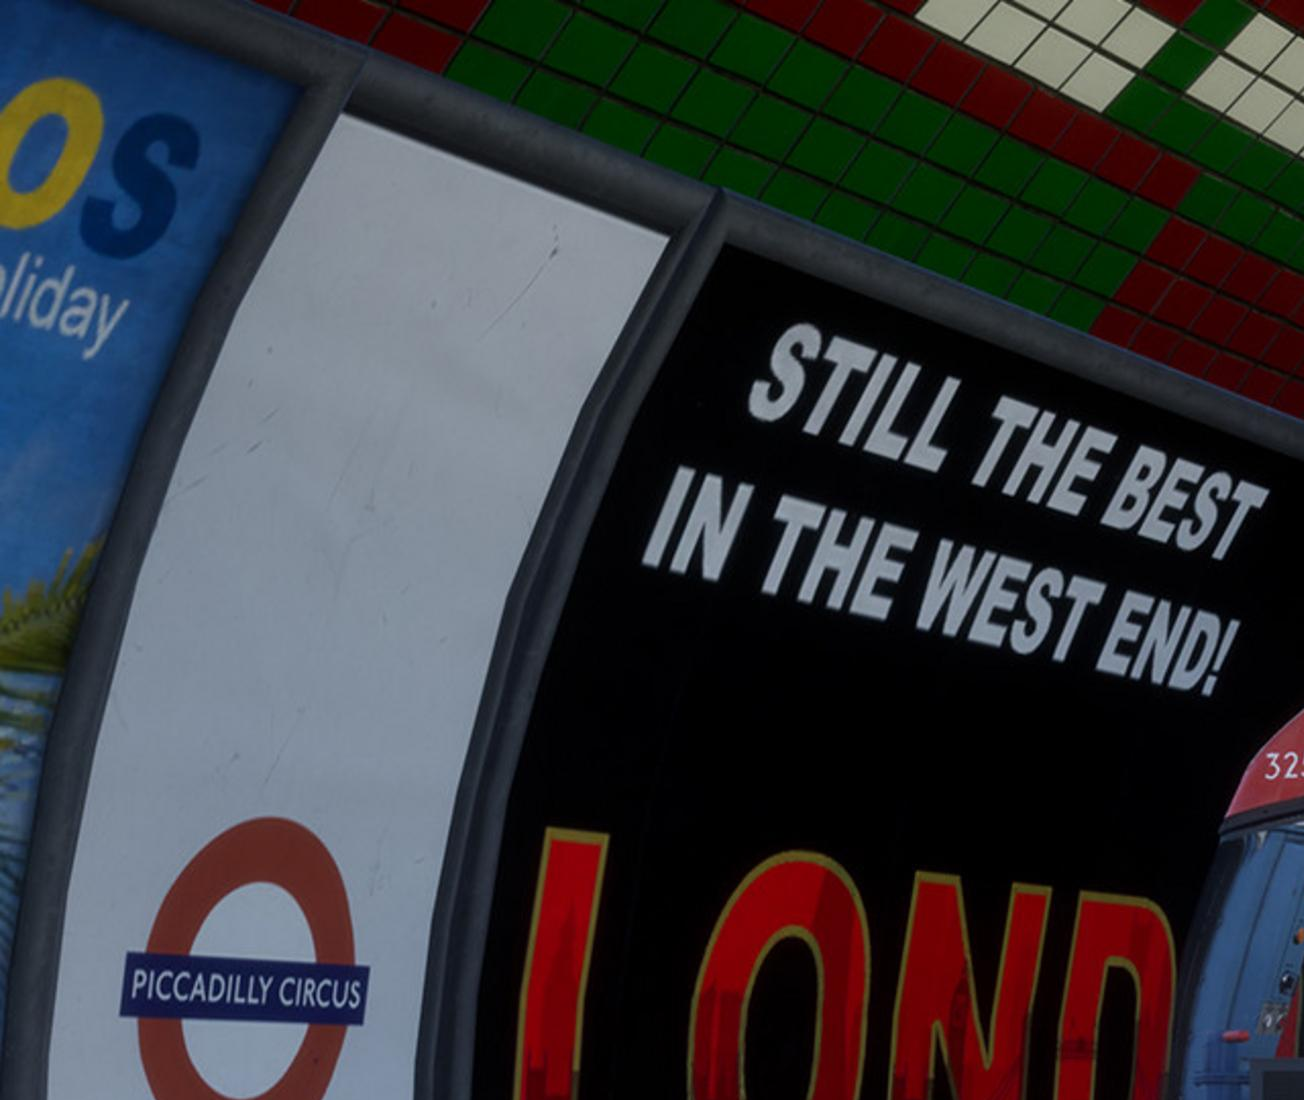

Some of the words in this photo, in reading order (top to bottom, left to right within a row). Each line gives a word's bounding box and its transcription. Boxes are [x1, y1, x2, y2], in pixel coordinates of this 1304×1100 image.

[0, 251, 130, 360] liday
[749, 323, 961, 473] STILL
[970, 395, 1118, 517] THE
[1100, 445, 1270, 561] BEST
[641, 465, 754, 582] IN
[761, 494, 920, 621] THE
[915, 538, 1106, 663] WEST
[1095, 590, 1241, 697] END!
[131, 969, 274, 1005] PICCADILLY
[279, 977, 361, 1009] CIRCUS
